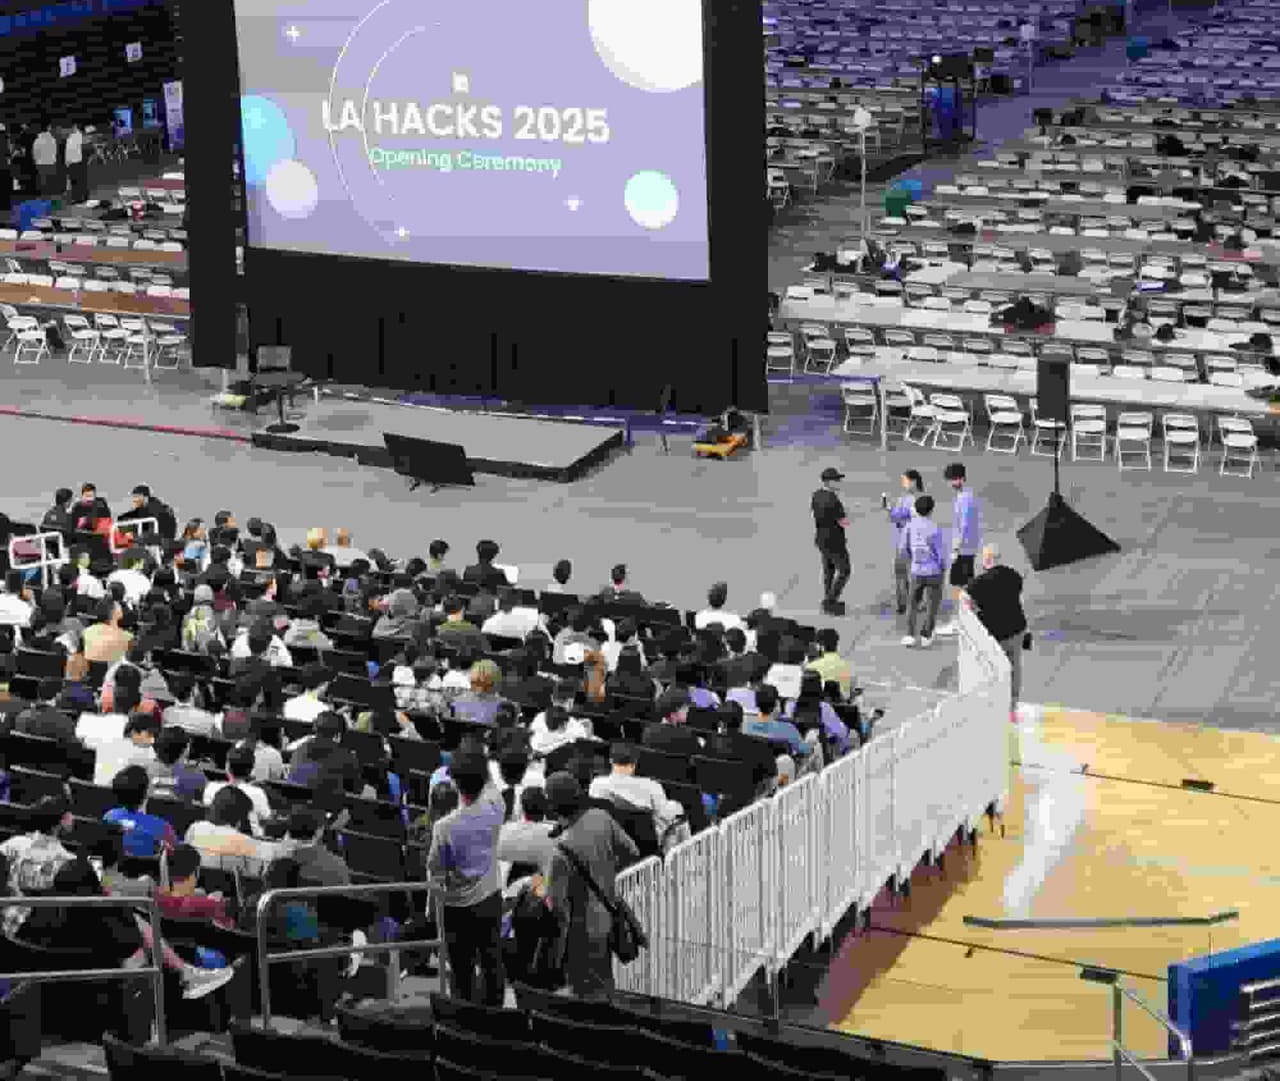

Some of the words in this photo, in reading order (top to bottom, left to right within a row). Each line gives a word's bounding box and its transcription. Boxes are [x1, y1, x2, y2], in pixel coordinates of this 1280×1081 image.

[321, 99, 362, 131] LA
[373, 101, 503, 137] HACKS
[513, 106, 610, 143] 2025
[368, 146, 452, 173] Opening
[457, 149, 562, 177] Ceremony
